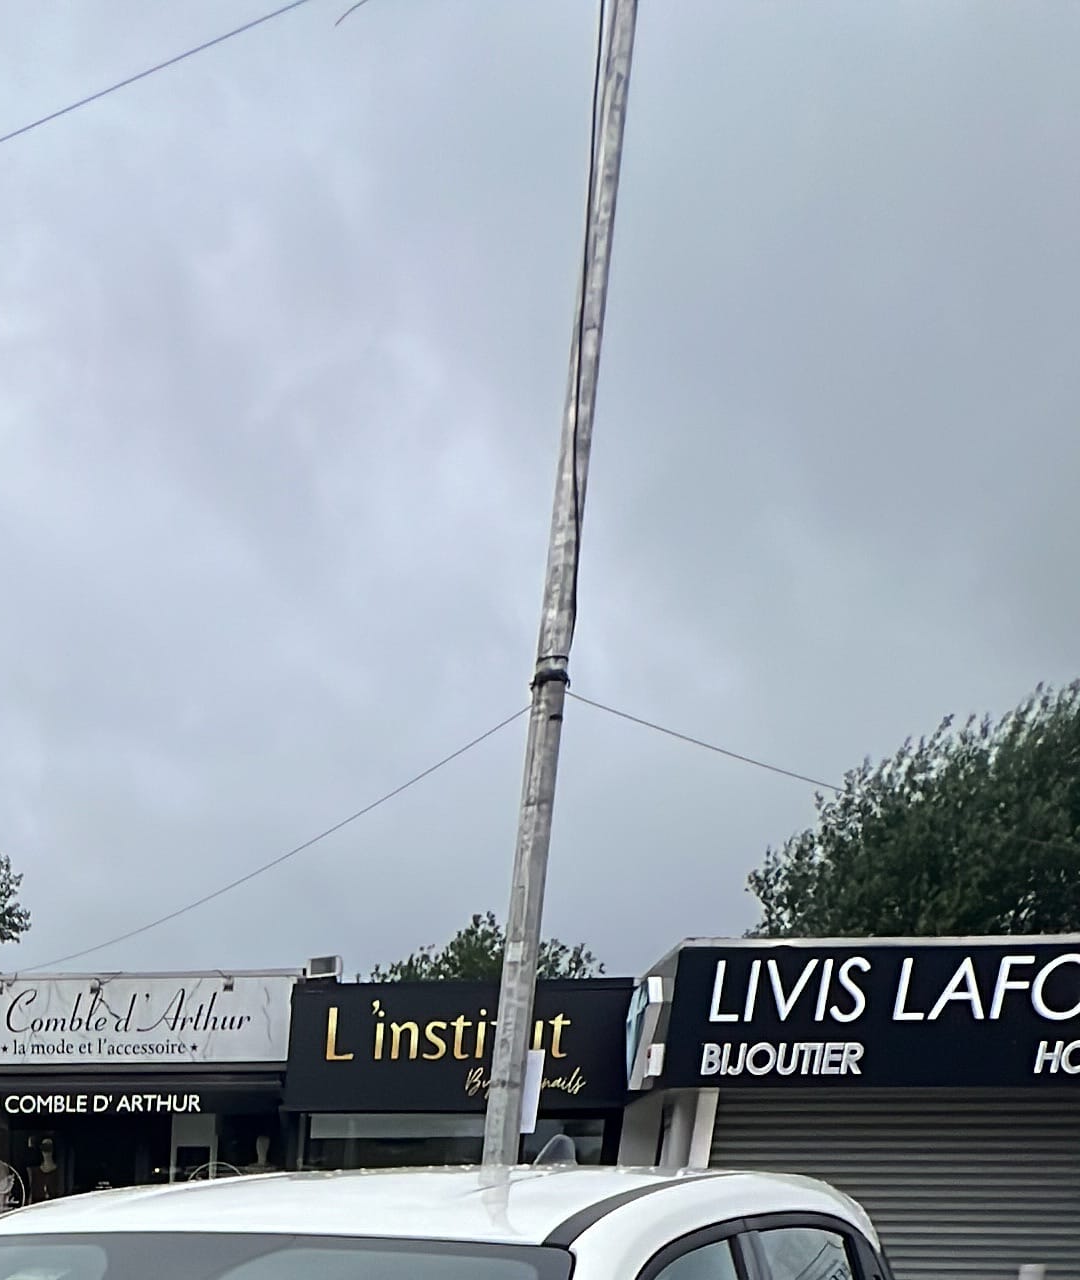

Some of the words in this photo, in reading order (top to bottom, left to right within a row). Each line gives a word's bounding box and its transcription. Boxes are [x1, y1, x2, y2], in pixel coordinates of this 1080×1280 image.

[709, 956, 871, 1023] LIVIS
[6, 988, 108, 1033] Comble
[12, 1038, 26, 1055] la
[30, 1038, 73, 1055] mode
[78, 1038, 94, 1055] et
[98, 1037, 186, 1056] l'accessoire
[700, 1041, 864, 1076] BIJOUTIER
[4, 1095, 87, 1113] COMBLE
[116, 1094, 201, 1112] ARTHUR
